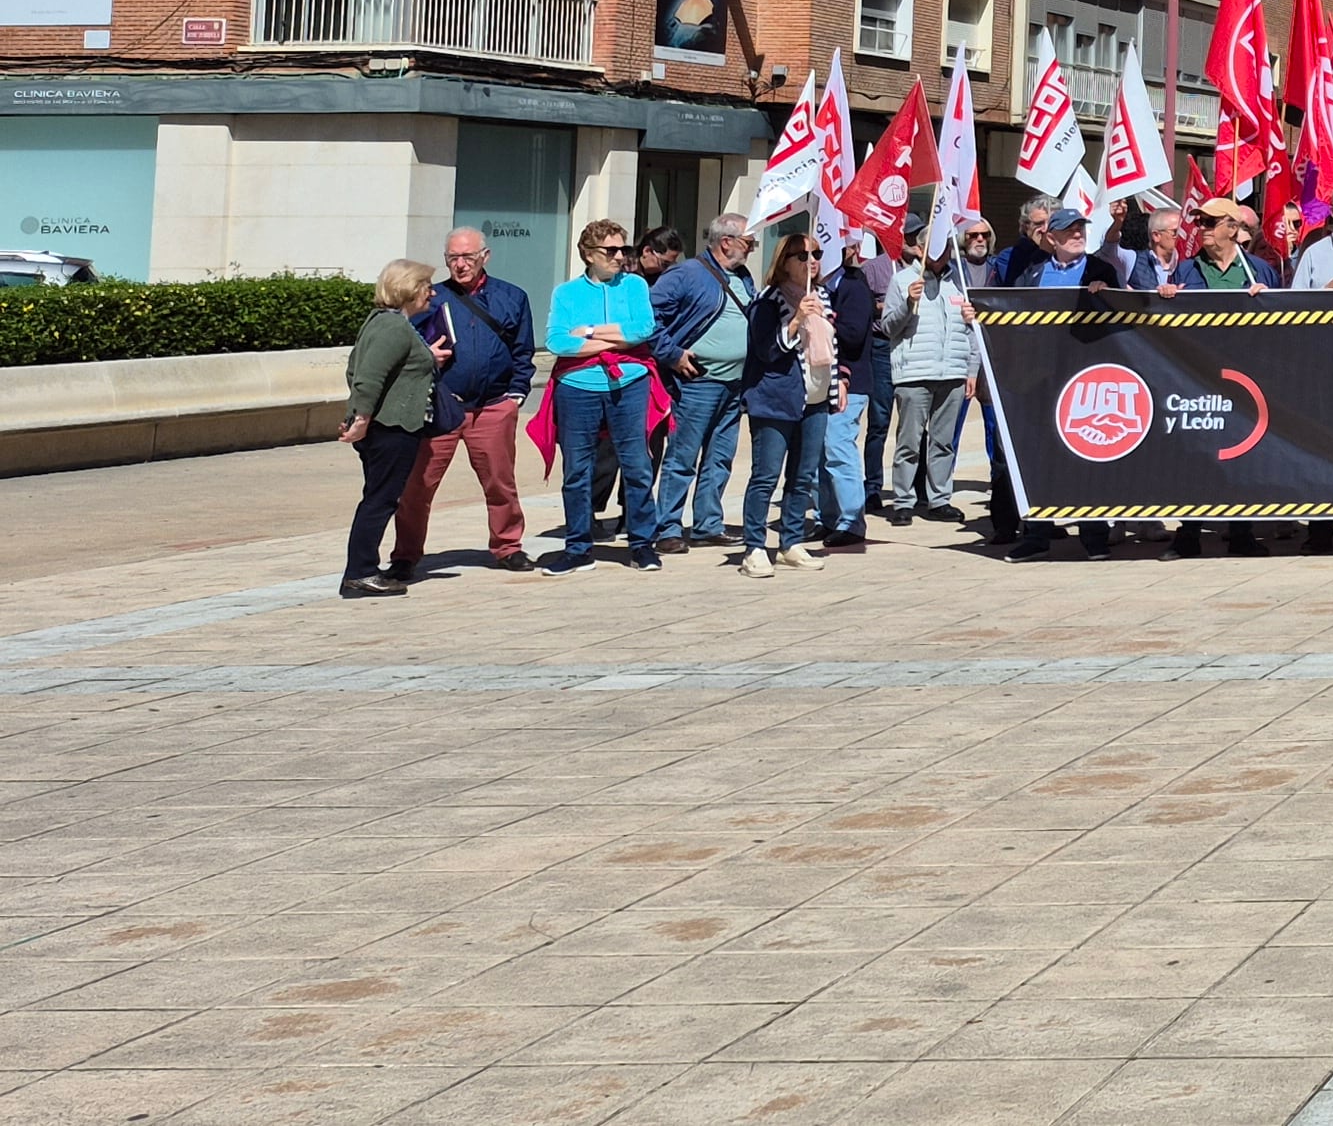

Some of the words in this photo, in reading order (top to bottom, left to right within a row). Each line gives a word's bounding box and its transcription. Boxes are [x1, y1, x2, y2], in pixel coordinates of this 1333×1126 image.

[14, 90, 63, 98] CLINICA
[67, 89, 120, 98] BAVIERA
[41, 225, 110, 234] BAVIERA
[492, 229, 531, 237] BAVIERA
[1073, 381, 1139, 417] UGT
[1166, 394, 1233, 414] Castilla
[1165, 417, 1176, 434] y
[1181, 412, 1225, 430] León
